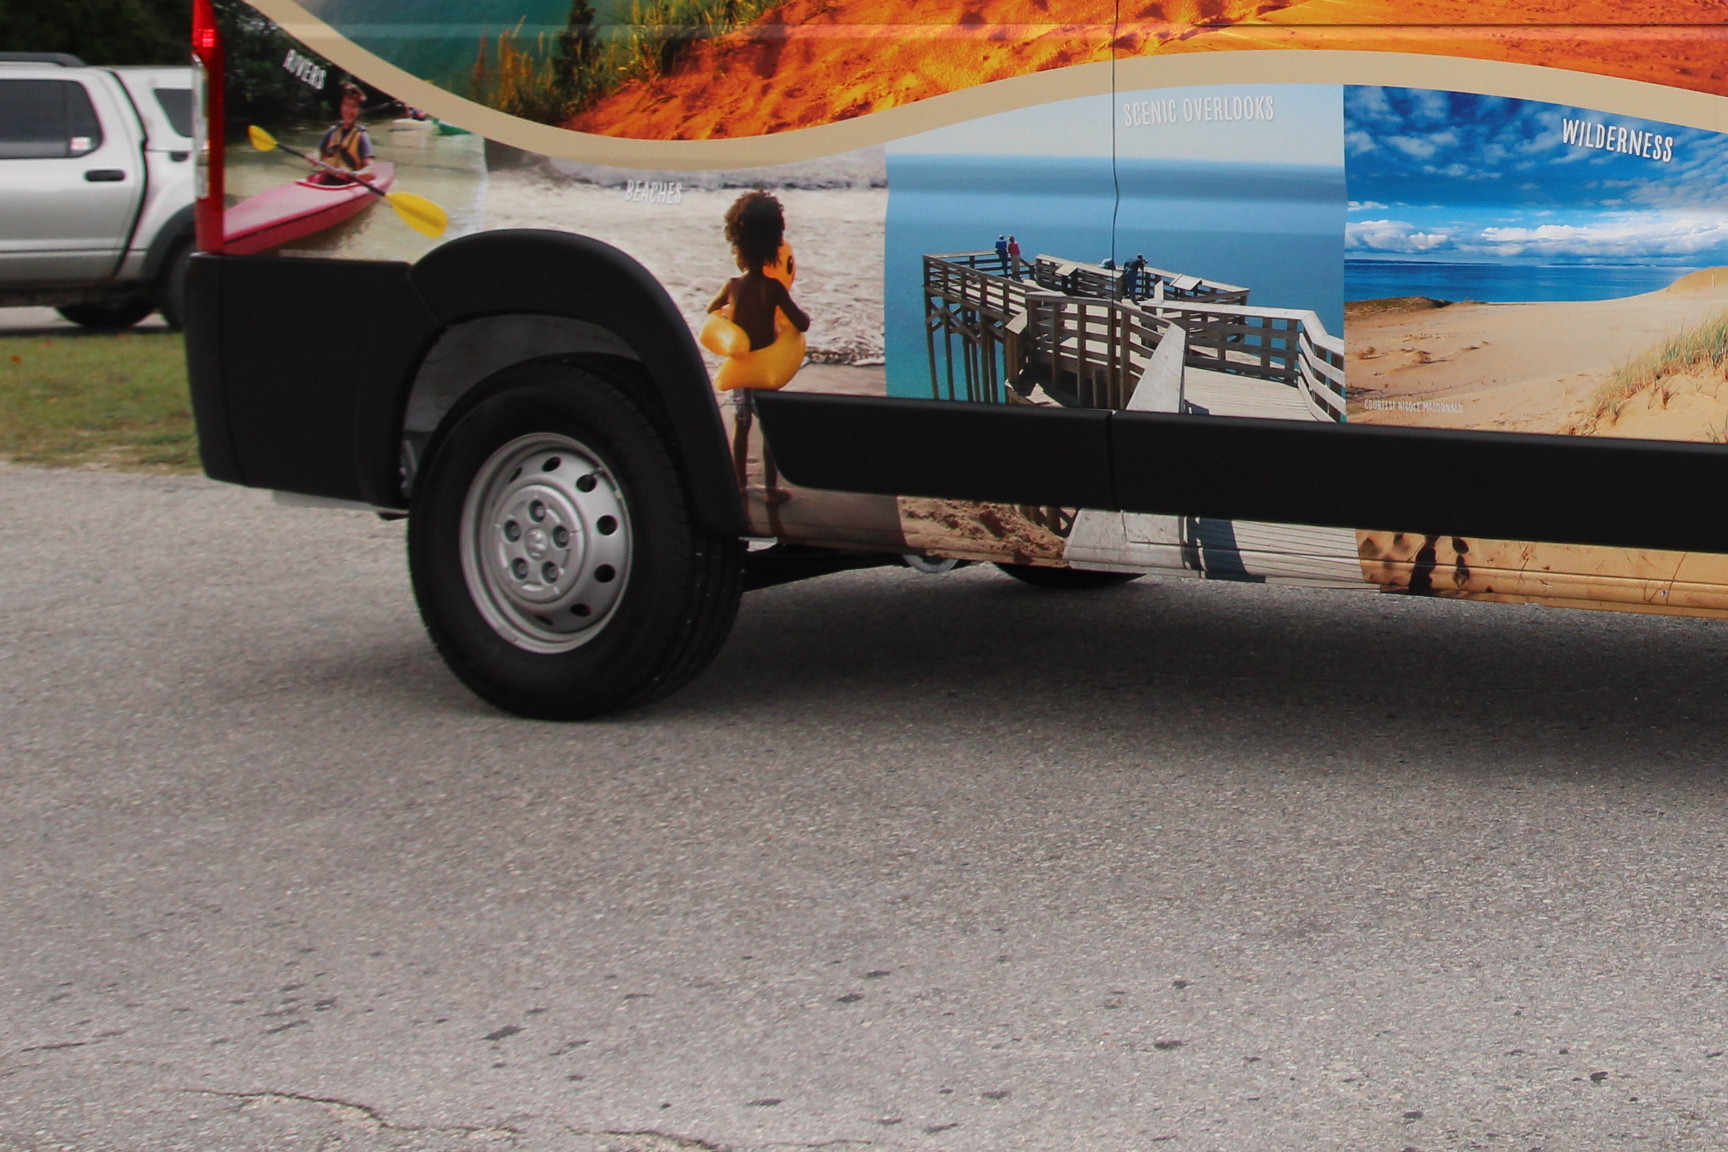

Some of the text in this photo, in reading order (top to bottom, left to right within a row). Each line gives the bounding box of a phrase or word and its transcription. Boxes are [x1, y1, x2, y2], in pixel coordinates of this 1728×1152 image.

[1123, 96, 1275, 127] SCENIC OVERLOOKS
[1562, 118, 1674, 163] WILDERNESS
[625, 179, 682, 204] BEACHES
